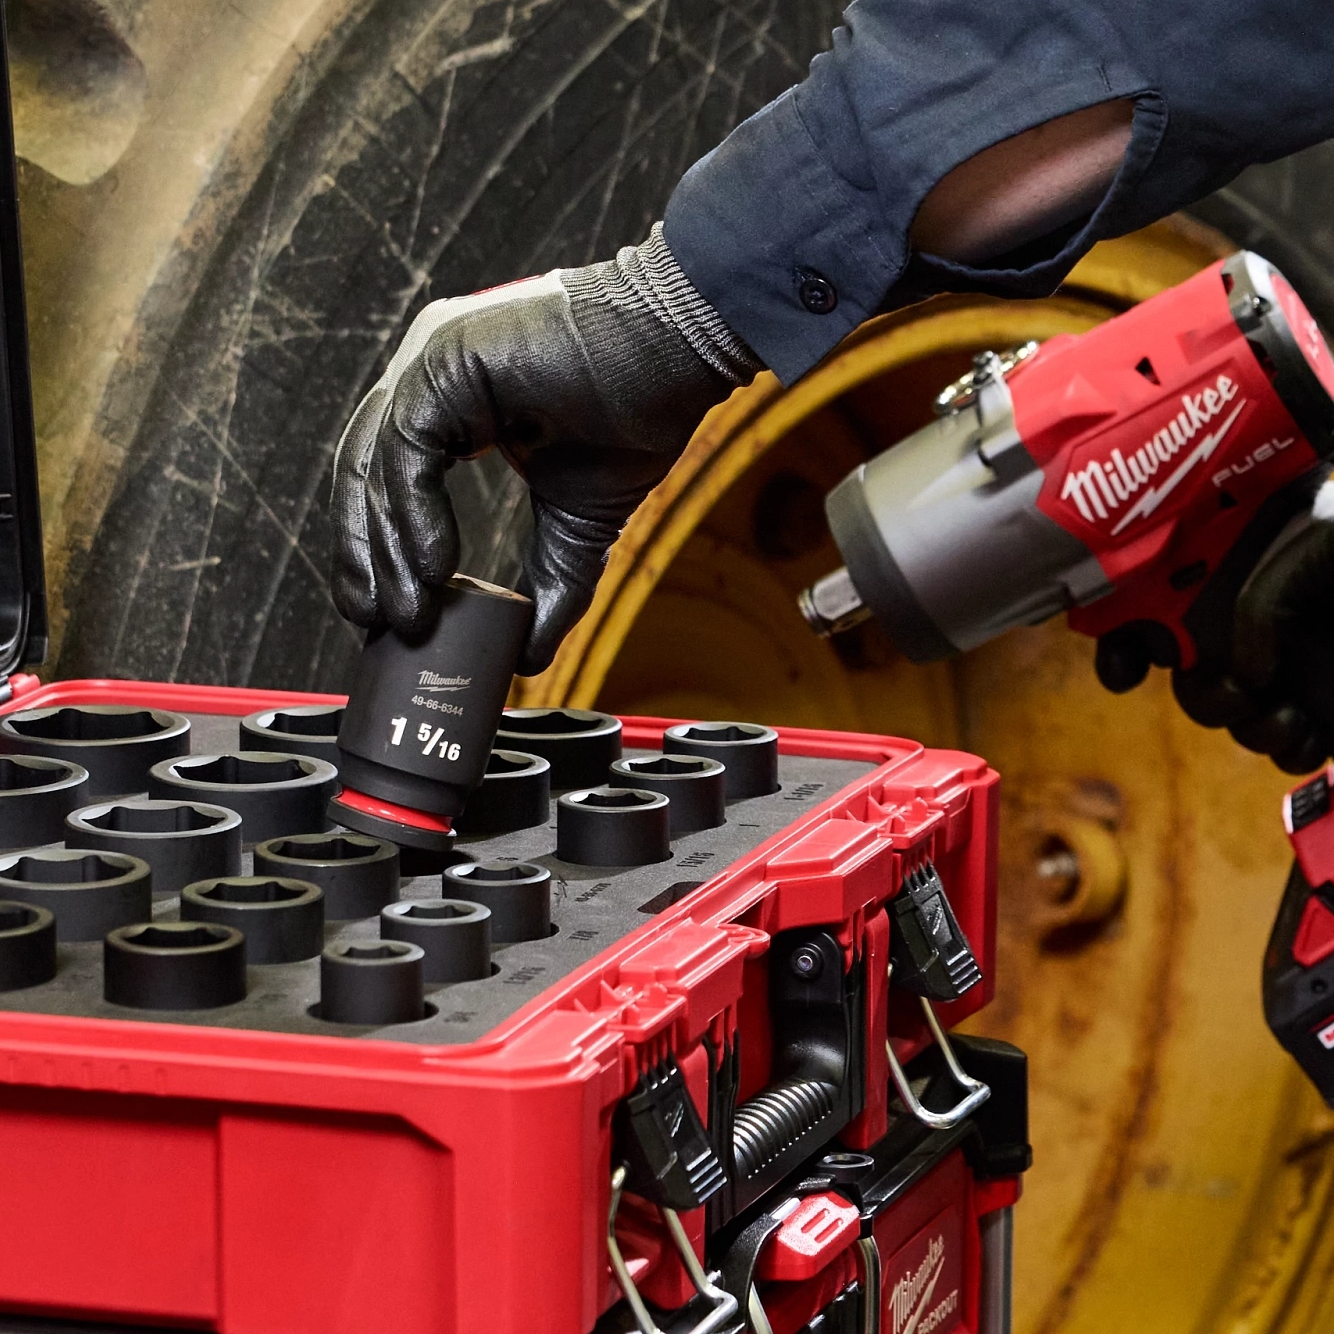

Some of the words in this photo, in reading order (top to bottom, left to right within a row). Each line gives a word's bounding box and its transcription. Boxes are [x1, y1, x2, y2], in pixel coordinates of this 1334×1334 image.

[1061, 374, 1239, 523] Milwaukee
[1211, 436, 1295, 487] FUEL
[418, 670, 471, 685] Milwaukee
[411, 694, 464, 716] 49-66-6344
[391, 716, 408, 746] 1
[417, 722, 461, 761] 5/16
